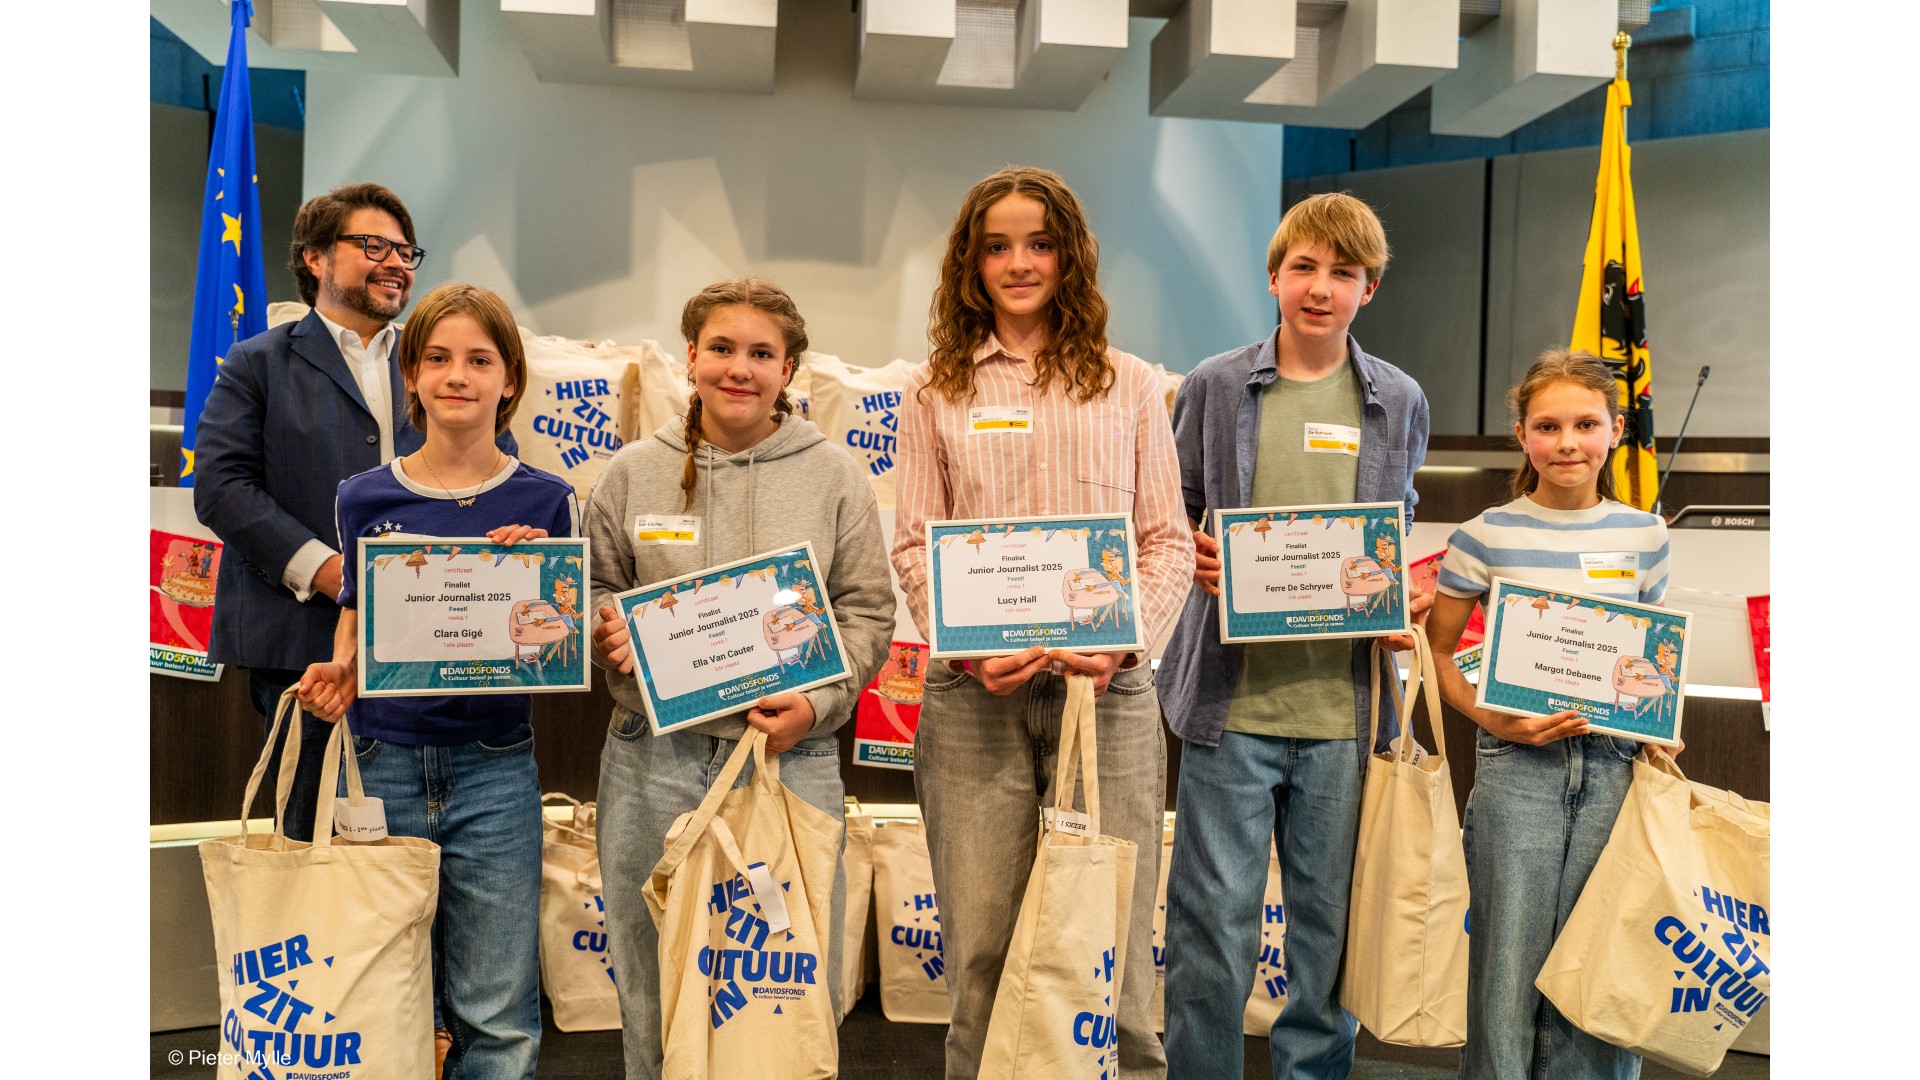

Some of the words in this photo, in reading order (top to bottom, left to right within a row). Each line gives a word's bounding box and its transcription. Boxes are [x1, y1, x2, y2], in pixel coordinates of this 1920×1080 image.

[555, 378, 611, 400] HIER
[572, 398, 612, 430] ZIT
[560, 443, 590, 470] IN
[870, 452, 894, 476] IN
[1724, 517, 1755, 526] BOSCH
[1254, 554, 1280, 562] Junior
[1281, 552, 1320, 561] Journalist
[1321, 551, 1341, 560] 2025
[967, 566, 995, 575] Junior
[997, 564, 1039, 573] Journalist
[1041, 563, 1063, 571] 2025
[1299, 582, 1334, 592] Schryver
[404, 593, 435, 602] Junior
[438, 593, 485, 602] Journalist
[487, 592, 511, 601] 2025
[997, 597, 1018, 605] Lucy
[1020, 595, 1037, 603] Hall
[697, 608, 722, 620] Finalist
[668, 628, 694, 641] Junior
[697, 614, 738, 633] Journalist
[738, 608, 760, 621] 2025
[1561, 626, 1584, 636] Finalist
[434, 629, 459, 638] Clara
[461, 629, 483, 639] Gigé
[1526, 630, 1553, 641] Junior
[1554, 635, 1595, 650] Journalist
[1597, 643, 1618, 654] 2025
[692, 657, 709, 669] Ella
[709, 653, 726, 664] Van
[727, 645, 755, 658] Cauter
[164, 662, 185, 670] beleef
[1534, 662, 1564, 675] Margot
[1566, 668, 1602, 682] Debaene
[1065, 821, 1087, 830] REEKS
[1701, 885, 1770, 936] HIER
[1721, 922, 1770, 980] ZIT
[233, 933, 313, 986] HIER
[759, 987, 806, 996] DAVIDSFONDS
[1670, 986, 1711, 1013] IN
[243, 979, 314, 1034] ZIT
[293, 1071, 351, 1080] DAVIDSFONDS
